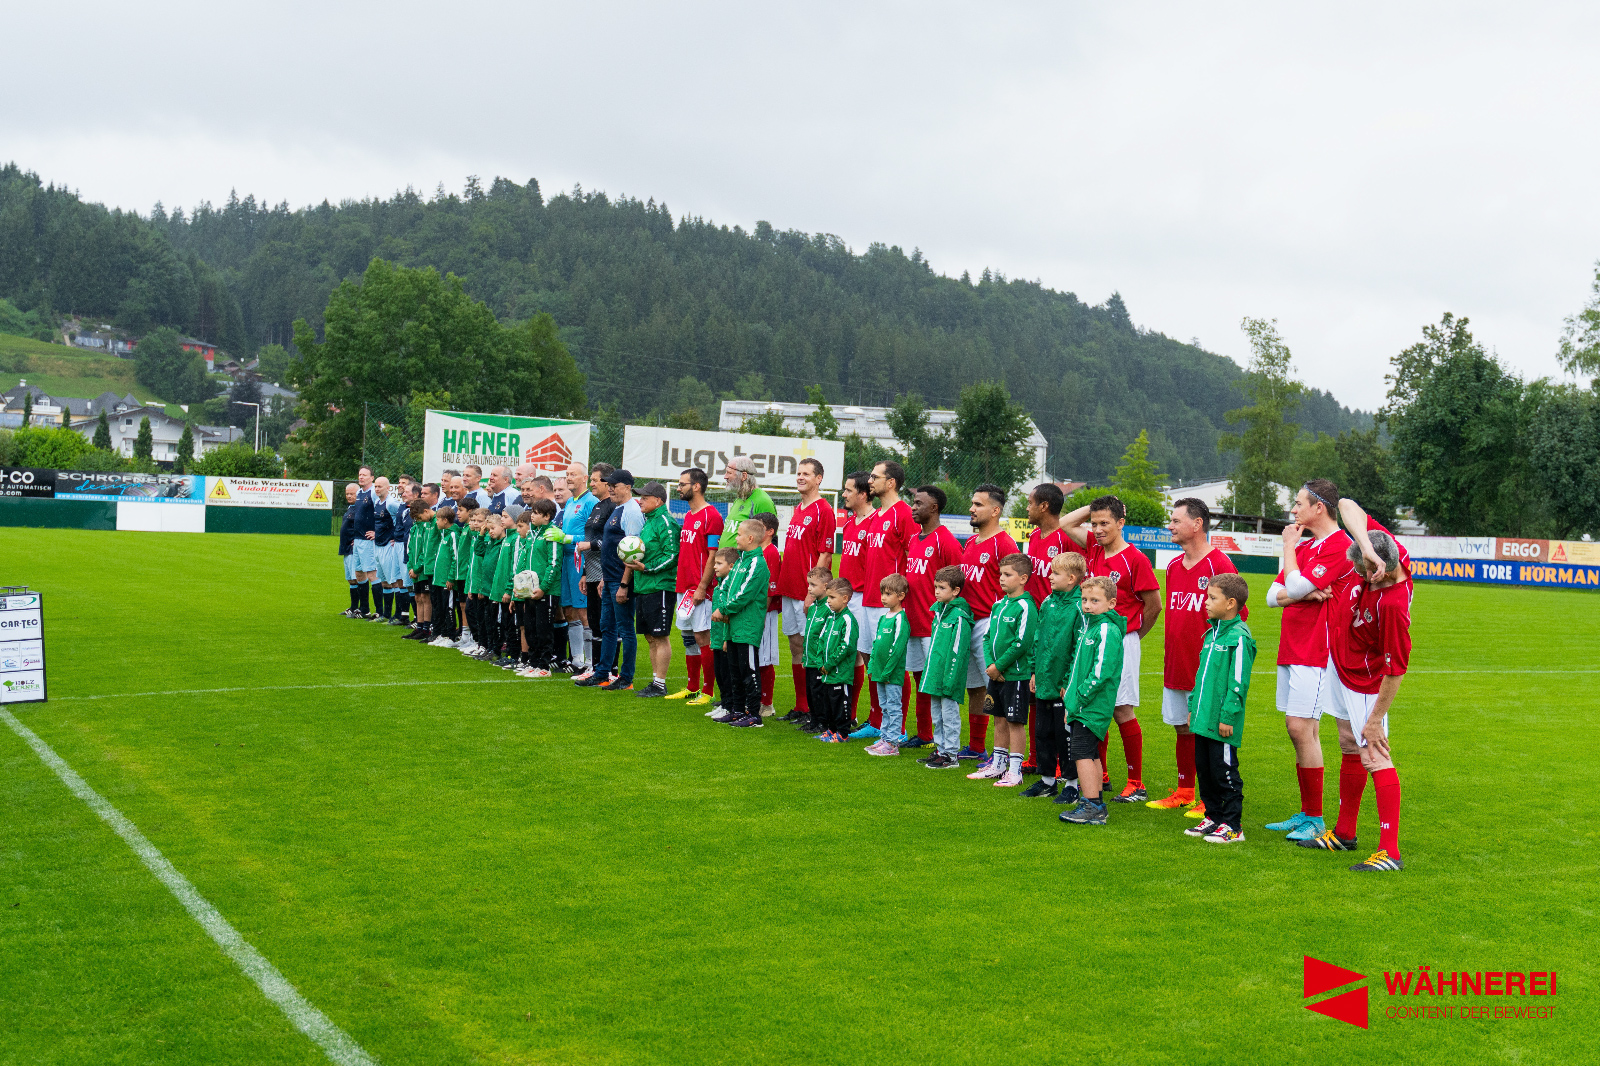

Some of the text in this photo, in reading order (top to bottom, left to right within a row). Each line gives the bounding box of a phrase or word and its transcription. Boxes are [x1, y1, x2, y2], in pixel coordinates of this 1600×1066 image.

[443, 428, 521, 457] HAFNER
[442, 452, 520, 467] BAU & SCHALUNGSVERLEIH
[58, 472, 169, 485] SCHROFNER
[261, 480, 310, 488] Werkstätte
[74, 479, 144, 496] design
[1127, 532, 1173, 543] MATZELSBE
[1501, 542, 1541, 558] ERGO
[1408, 560, 1600, 586] ÖRMANN TORE HÖRMAN
[1170, 591, 1205, 613] EVN
[0, 618, 39, 629] CAR-TEC
